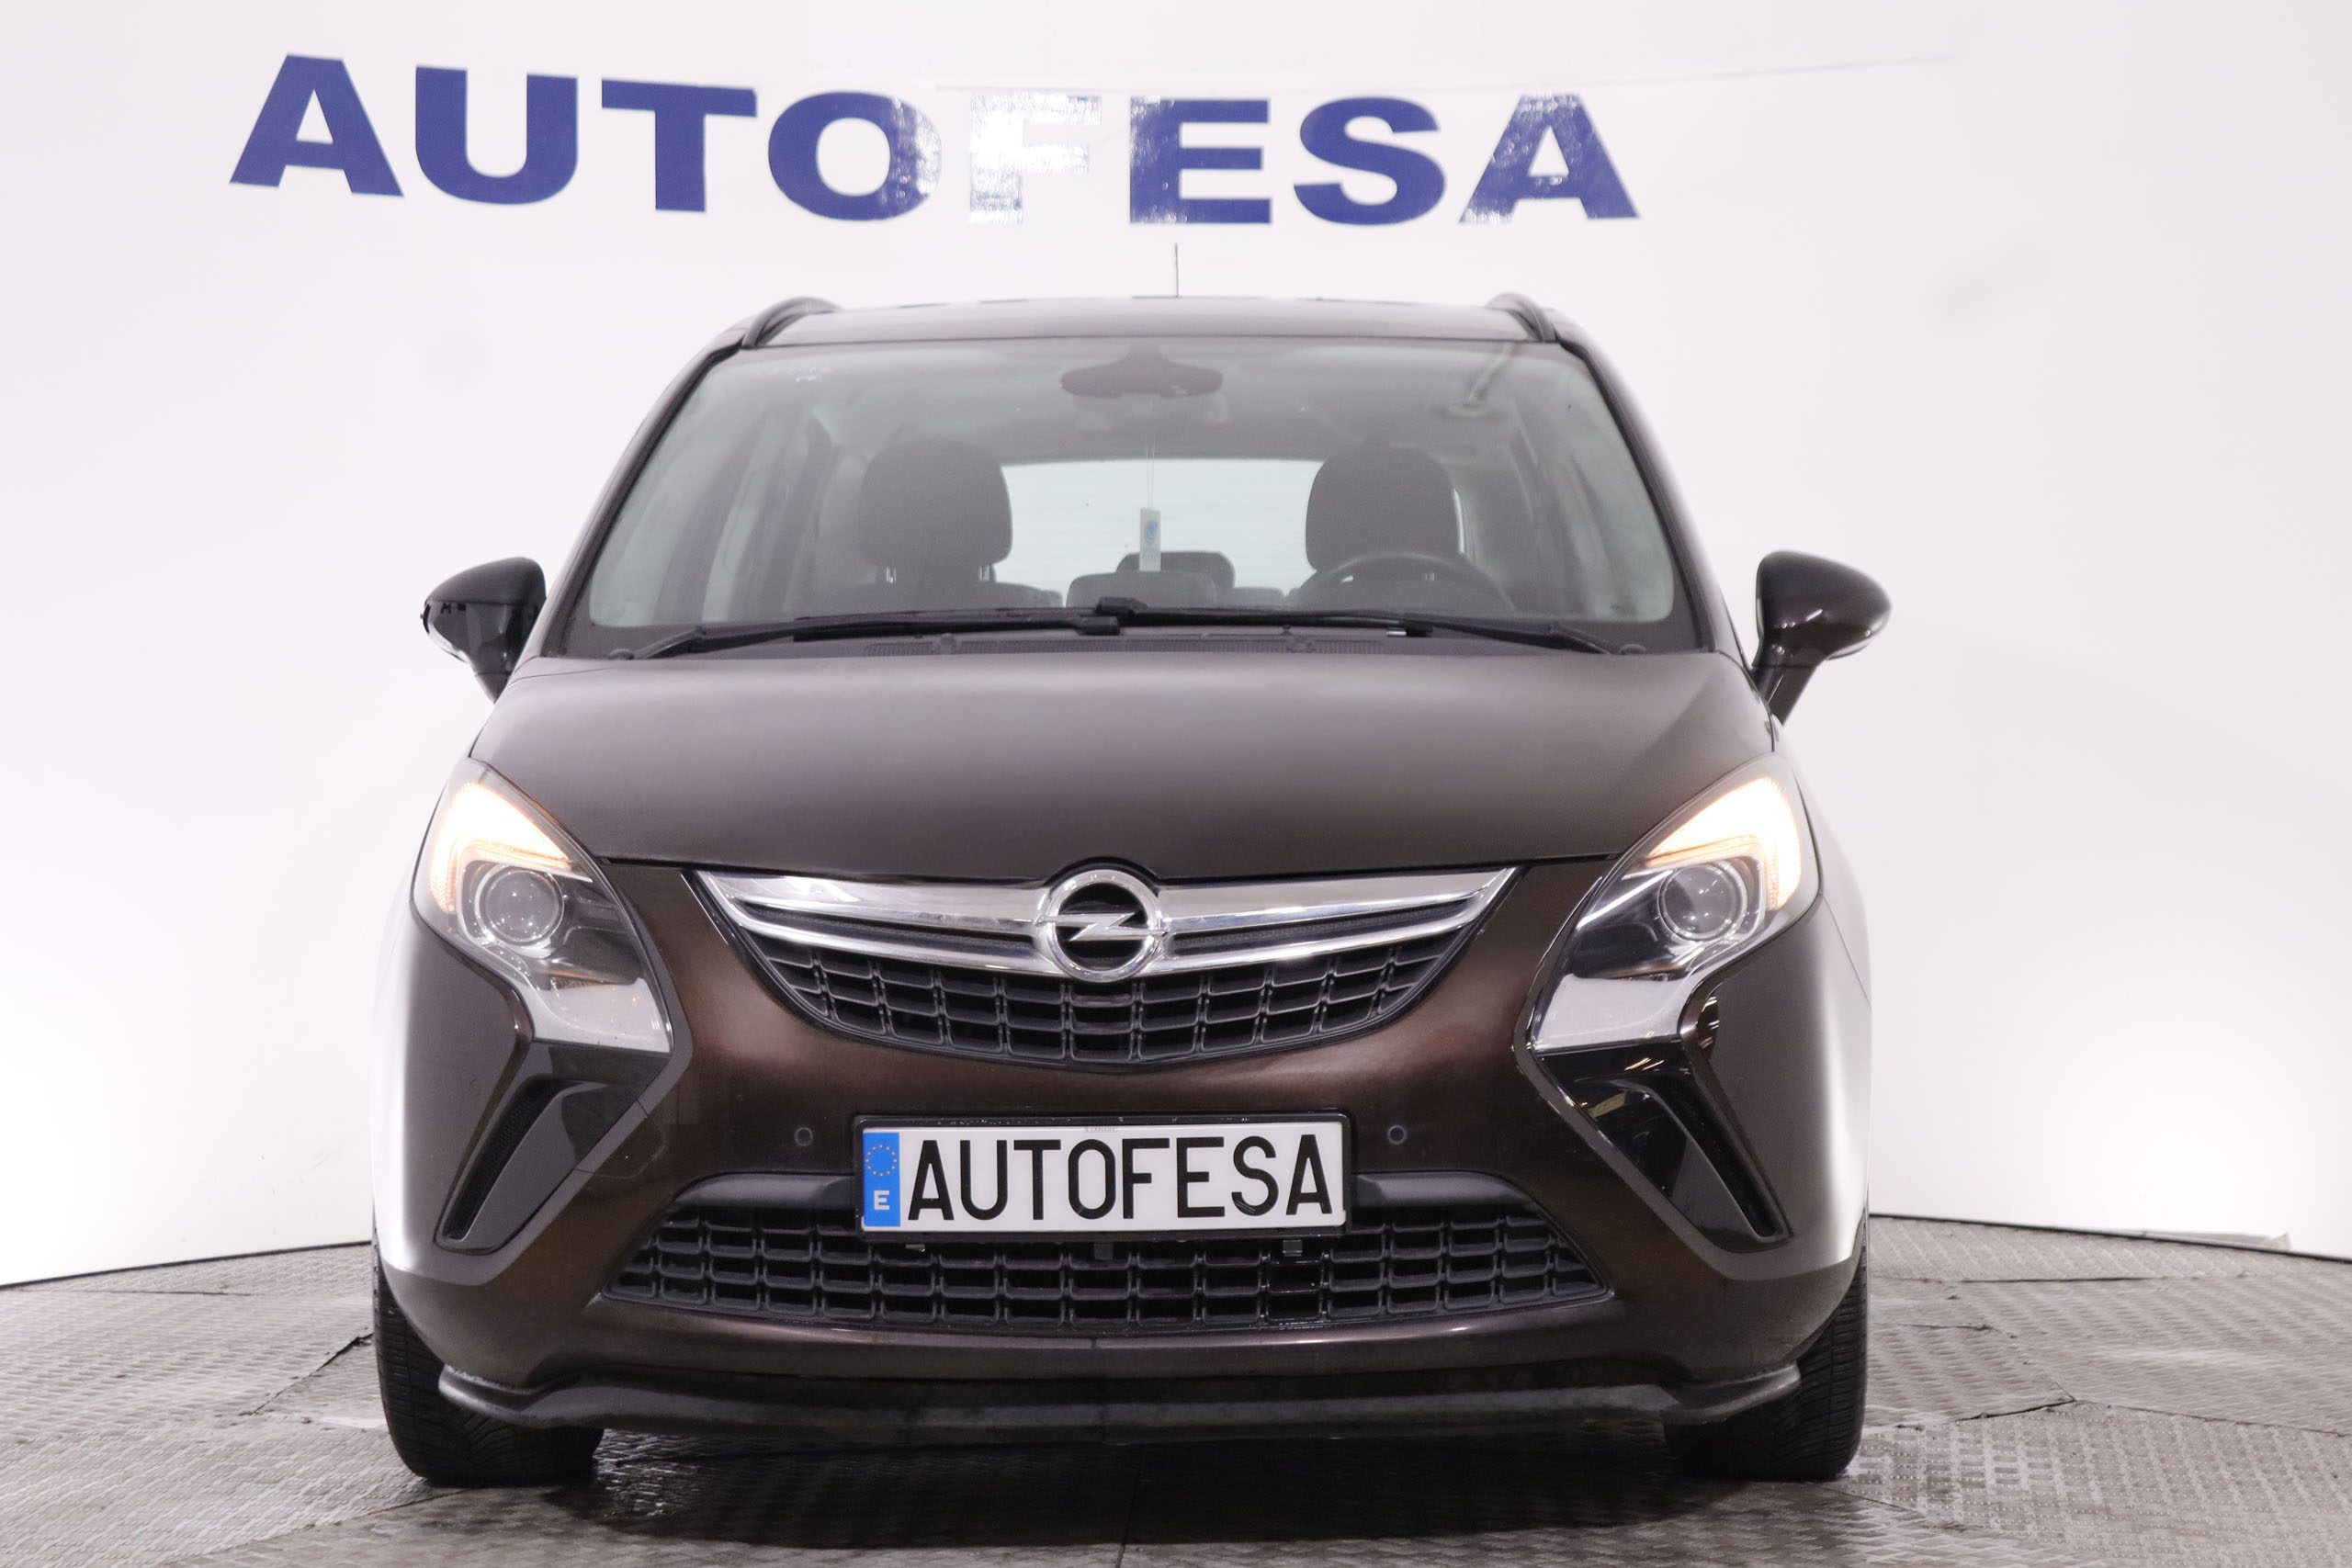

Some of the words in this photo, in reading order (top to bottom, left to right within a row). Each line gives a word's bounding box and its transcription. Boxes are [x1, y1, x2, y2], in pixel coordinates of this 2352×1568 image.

[230, 54, 1640, 227] AUTOFESA
[873, 1190, 890, 1211] E
[908, 1134, 1332, 1222] AUTOFESA
